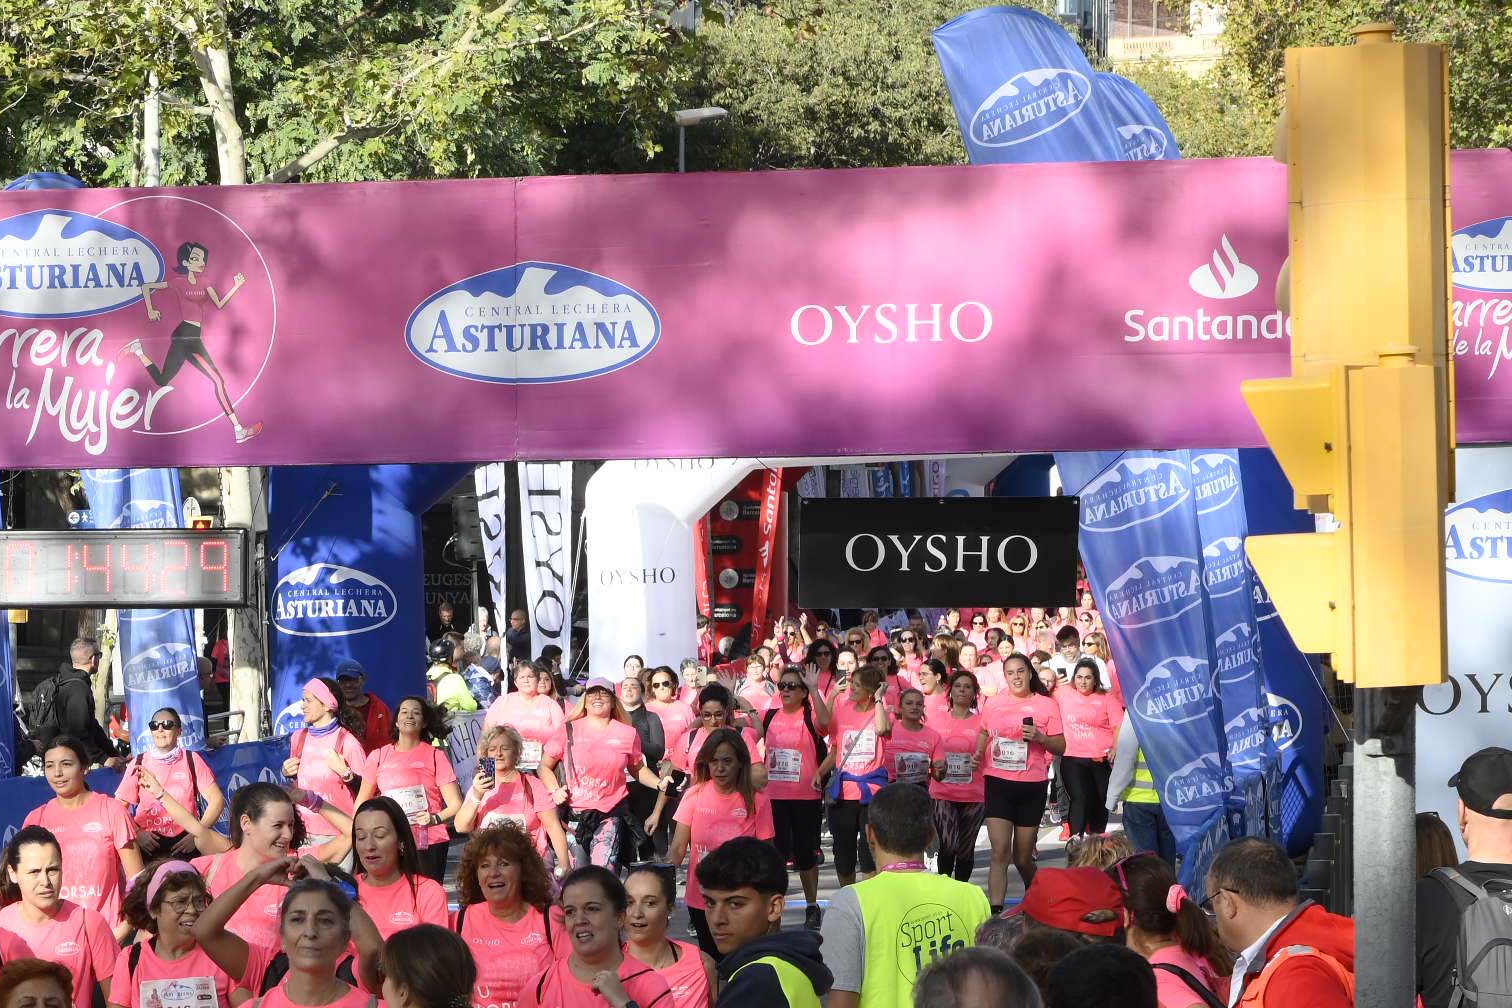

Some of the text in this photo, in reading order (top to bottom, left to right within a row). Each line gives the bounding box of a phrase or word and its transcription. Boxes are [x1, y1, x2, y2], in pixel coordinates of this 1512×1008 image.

[68, 245, 140, 257] LECHERA
[1451, 247, 1512, 274] STU
[464, 303, 633, 317] CENTRAL LECHERA
[789, 301, 993, 346] OYSHO
[424, 308, 641, 354] ASTURIANA
[6, 366, 30, 410] la
[25, 363, 175, 456] Mujer
[844, 532, 1039, 574] OYSHO
[600, 566, 676, 585] OYSHO
[276, 593, 388, 621] ASTURIANA
[287, 588, 384, 598] CENTRAL LECHERA
[1417, 673, 1512, 716] OY
[900, 911, 955, 948] Sport
